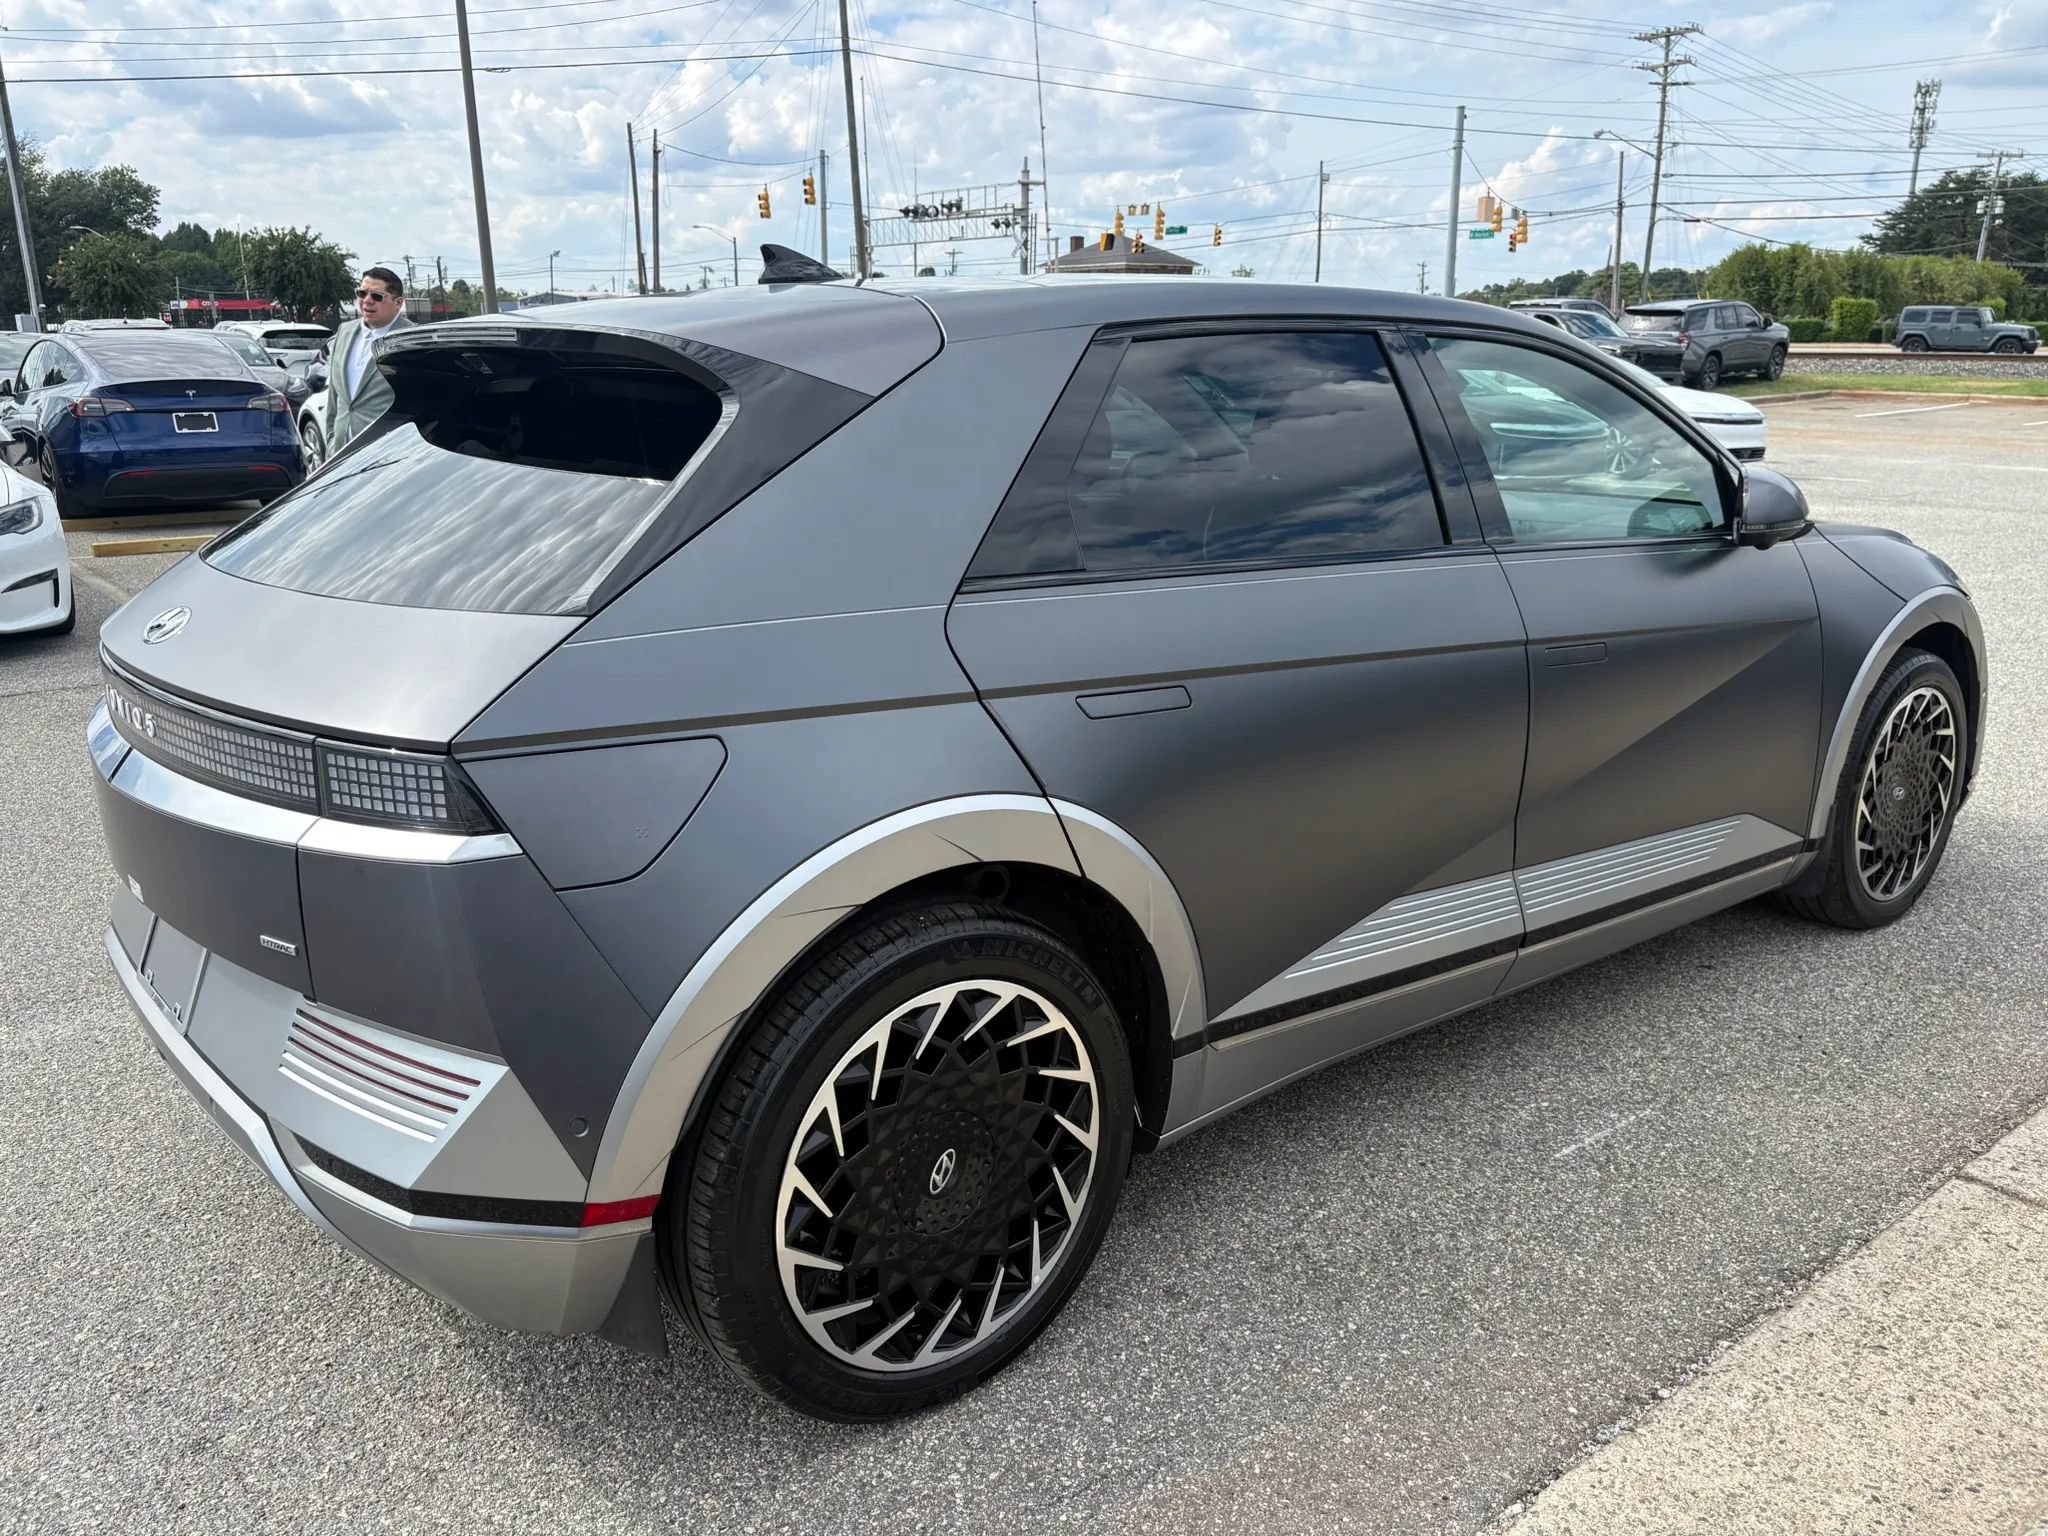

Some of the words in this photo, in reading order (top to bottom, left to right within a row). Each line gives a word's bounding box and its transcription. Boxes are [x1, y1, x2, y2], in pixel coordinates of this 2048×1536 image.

[145, 713, 156, 737] 5
[262, 938, 293, 954] HTRAC
[982, 939, 1101, 1006] MICHELIN
